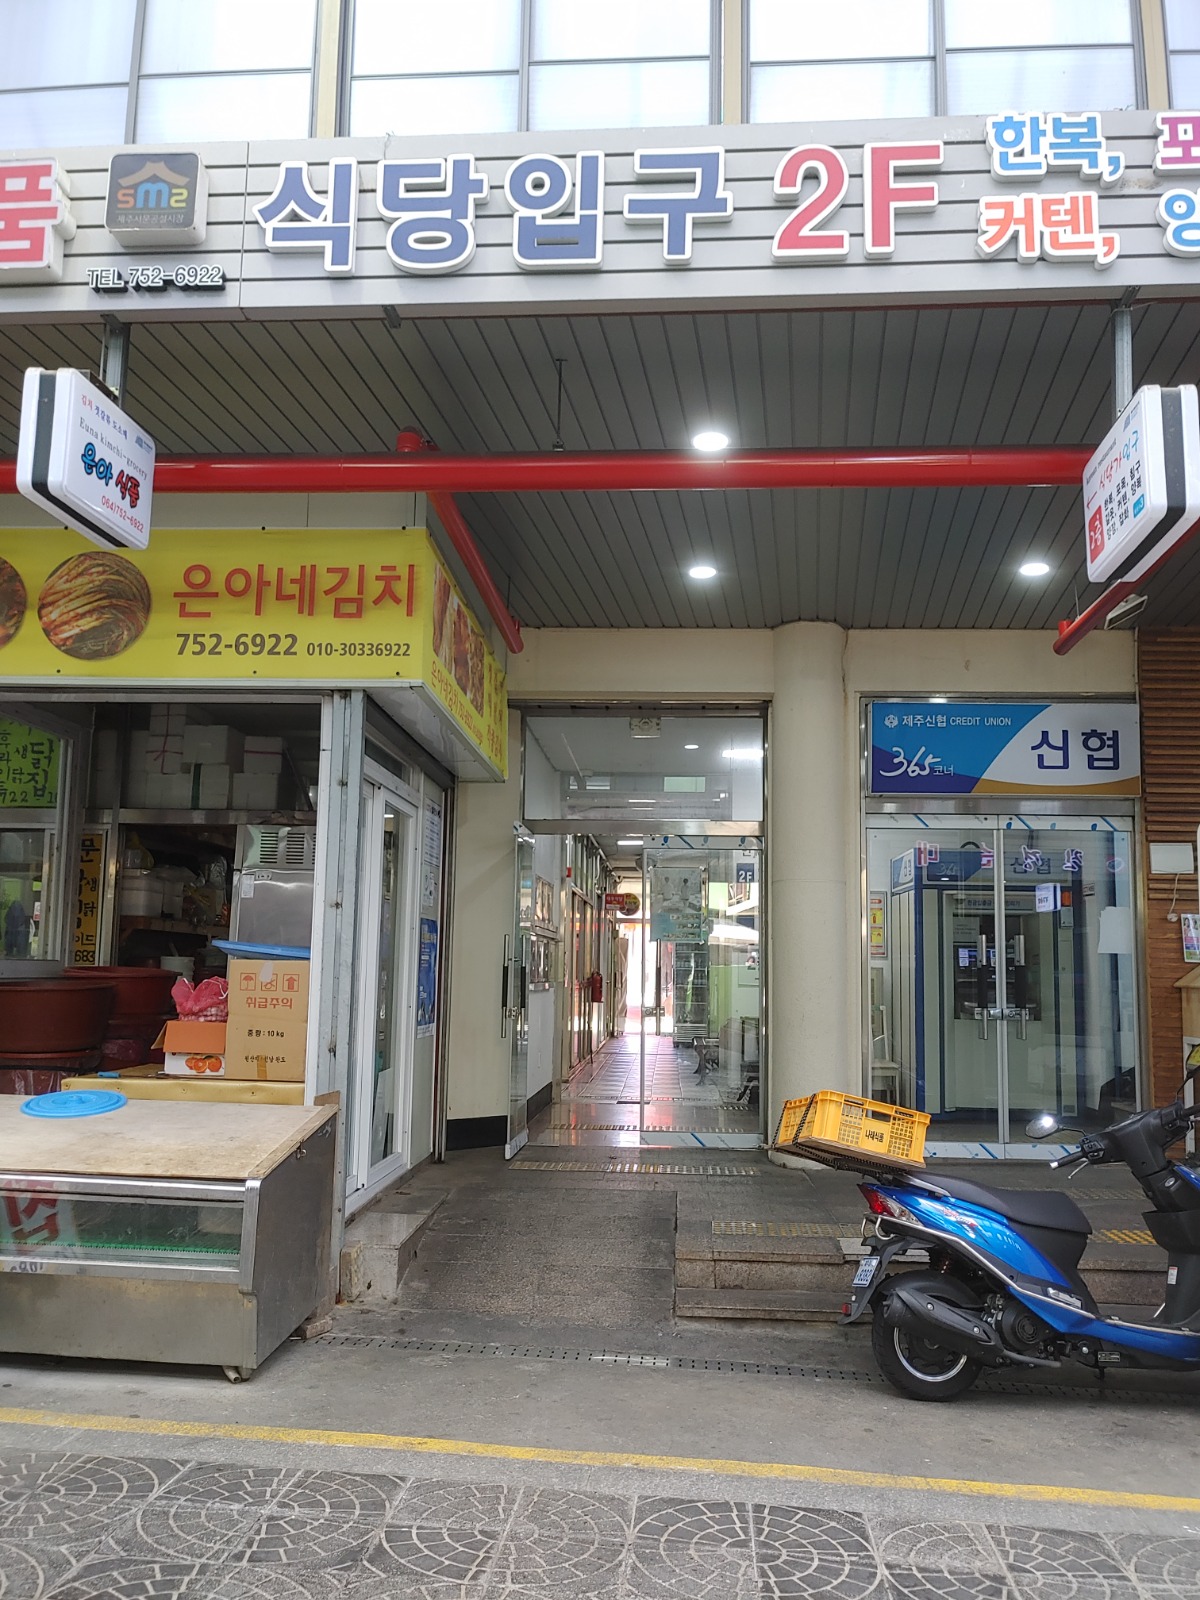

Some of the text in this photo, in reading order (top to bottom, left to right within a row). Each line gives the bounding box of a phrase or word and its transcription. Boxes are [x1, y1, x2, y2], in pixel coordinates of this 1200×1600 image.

[990, 114, 1125, 186] 한복,
[774, 141, 944, 259] 2F
[978, 192, 1120, 267] 커텐,
[87, 265, 223, 288] TEL 752-6922
[81, 394, 93, 411] 김치
[79, 417, 99, 440] Euna
[81, 443, 113, 486] 은아
[115, 469, 140, 509] 식품
[101, 495, 145, 534] 064)752-6922
[172, 562, 416, 620] 은아네김치
[176, 633, 411, 658] 752-6922 010-30336922
[902, 714, 1011, 728] 제주신협 CREDIT UNION
[1030, 729, 1120, 771] 신협
[739, 870, 752, 883] 2F
[246, 996, 293, 1010] 취급주의
[865, 1129, 885, 1143] 나래식품
